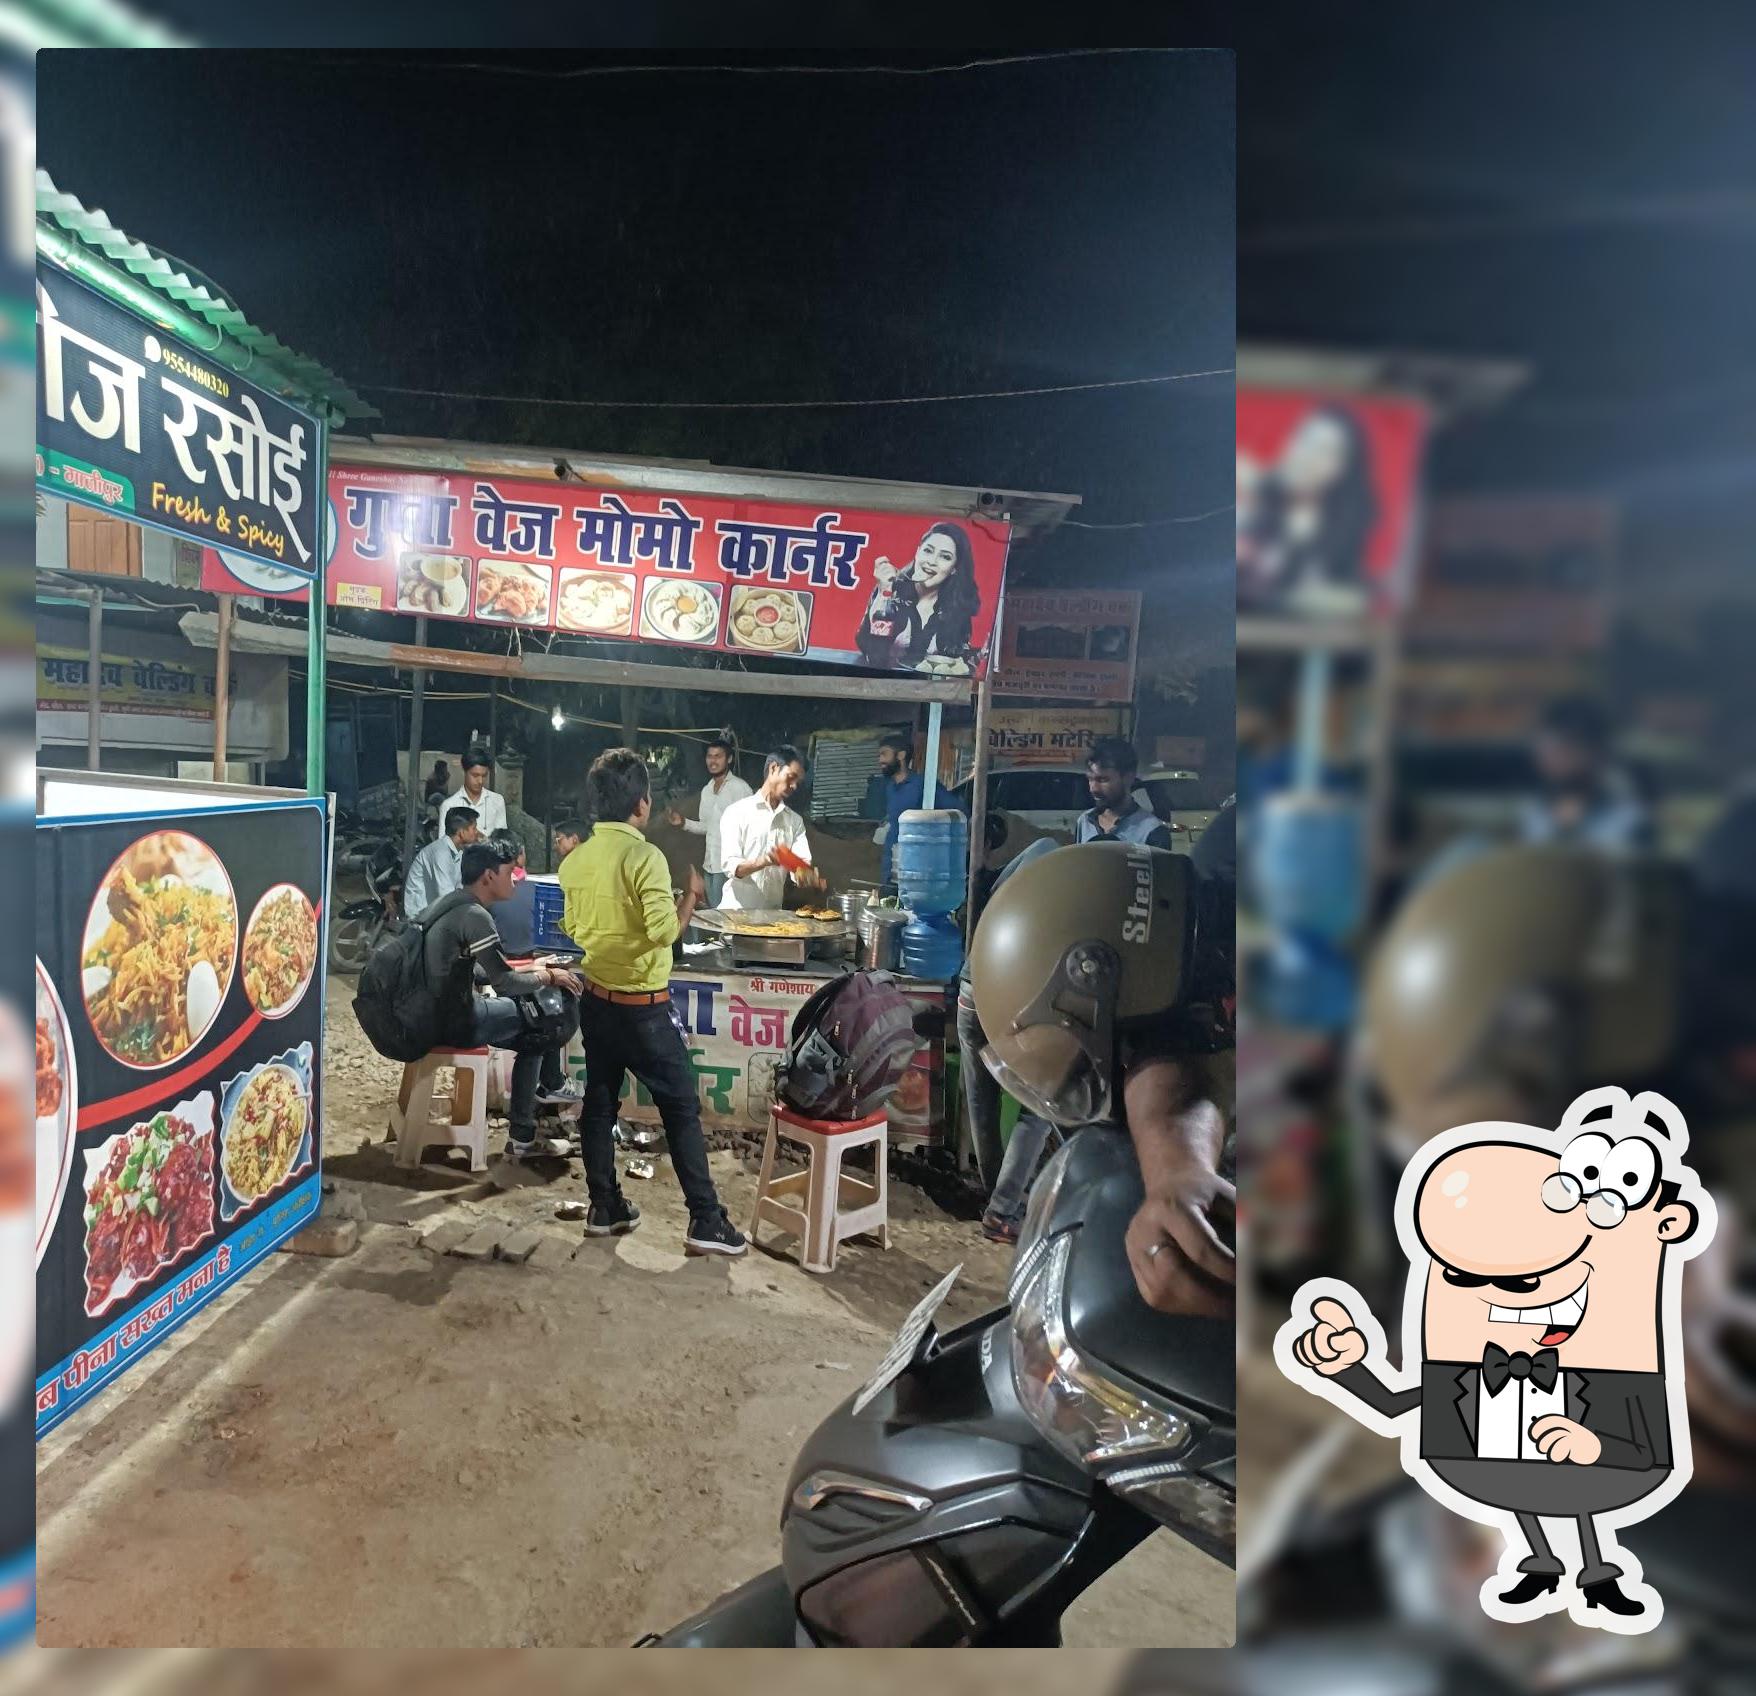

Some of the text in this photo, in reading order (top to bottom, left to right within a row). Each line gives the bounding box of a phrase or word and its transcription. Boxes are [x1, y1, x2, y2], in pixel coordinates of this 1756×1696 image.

[162, 347, 230, 398] 9554480320
[161, 376, 312, 563] रसोई
[151, 481, 285, 558] Fresh & Spicy
[471, 481, 563, 560] वेज
[573, 493, 703, 574] मोमो
[715, 512, 870, 591] कार्नर
[728, 994, 790, 1049] वेज
[750, 977, 766, 993] श्री
[62, 1333, 118, 1390] पीना
[175, 1256, 217, 1305] मना
[215, 1243, 233, 1275] है
